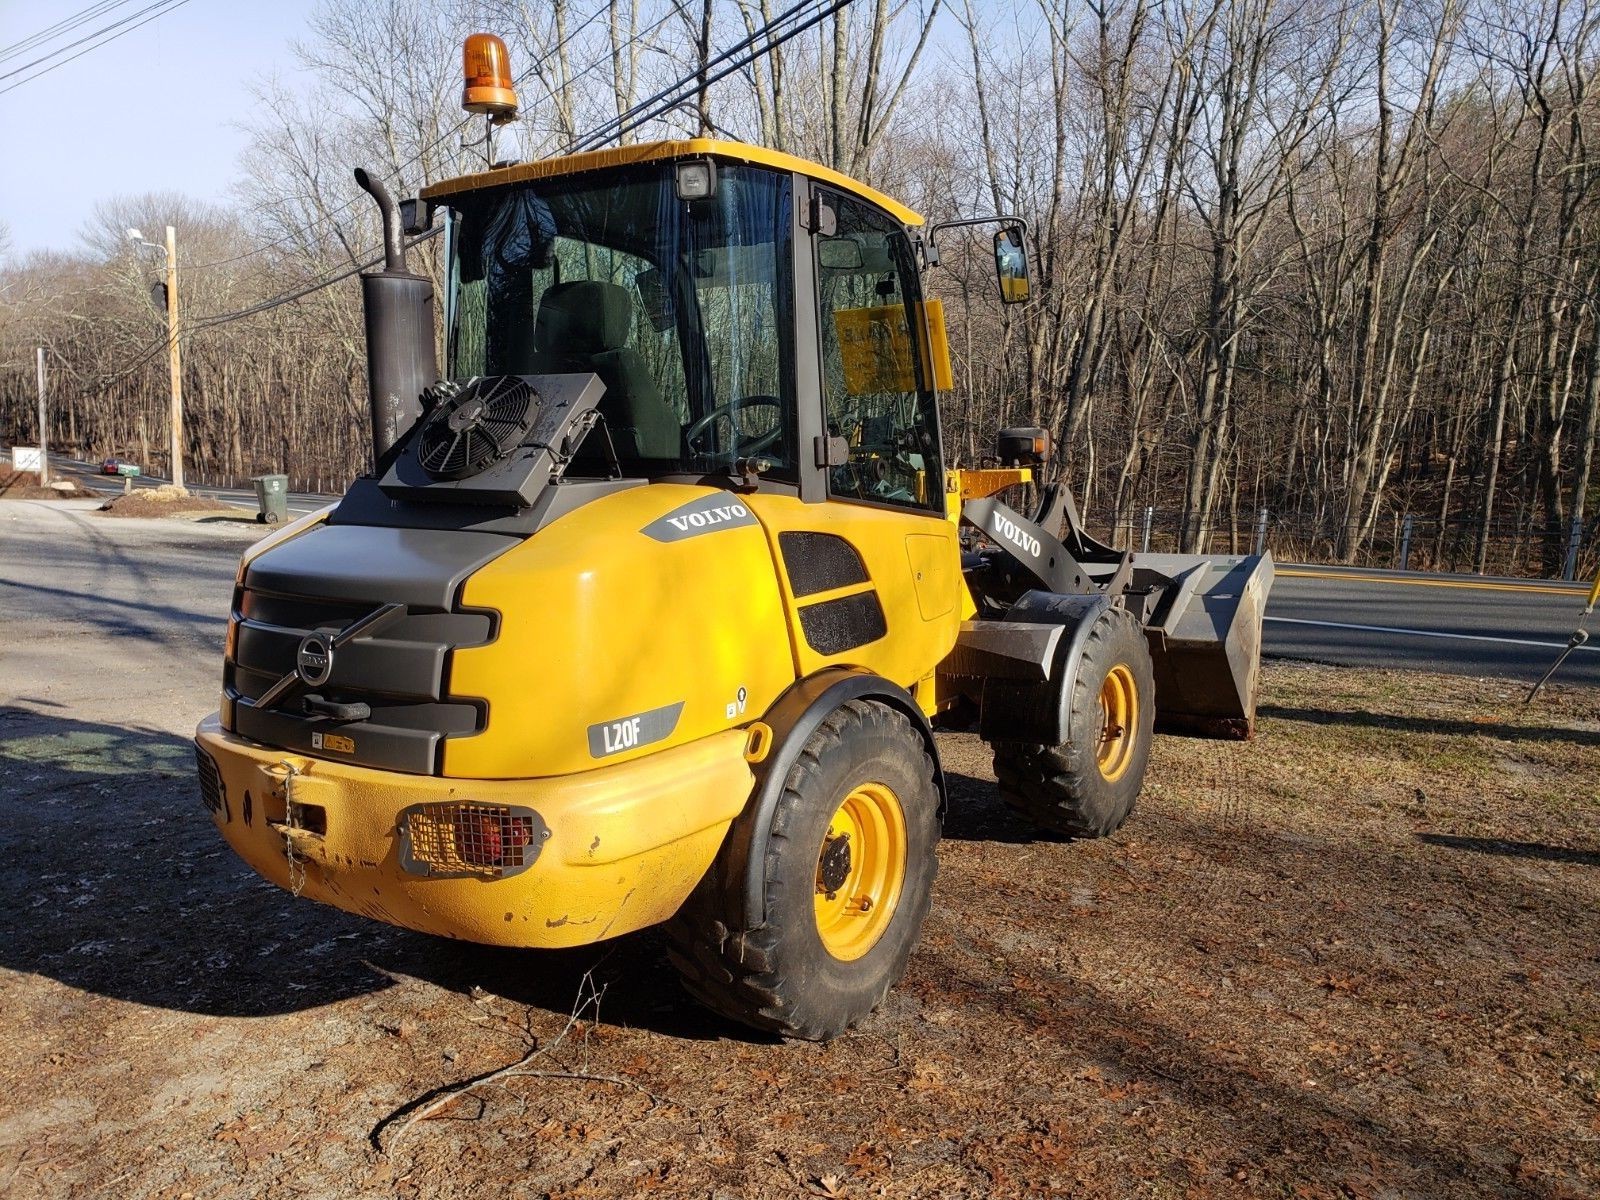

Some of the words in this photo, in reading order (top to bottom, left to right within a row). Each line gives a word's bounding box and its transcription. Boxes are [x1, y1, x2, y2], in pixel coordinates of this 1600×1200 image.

[667, 504, 747, 531] VOLVO
[993, 511, 1041, 558] VOLVO
[603, 717, 641, 754] L20F
